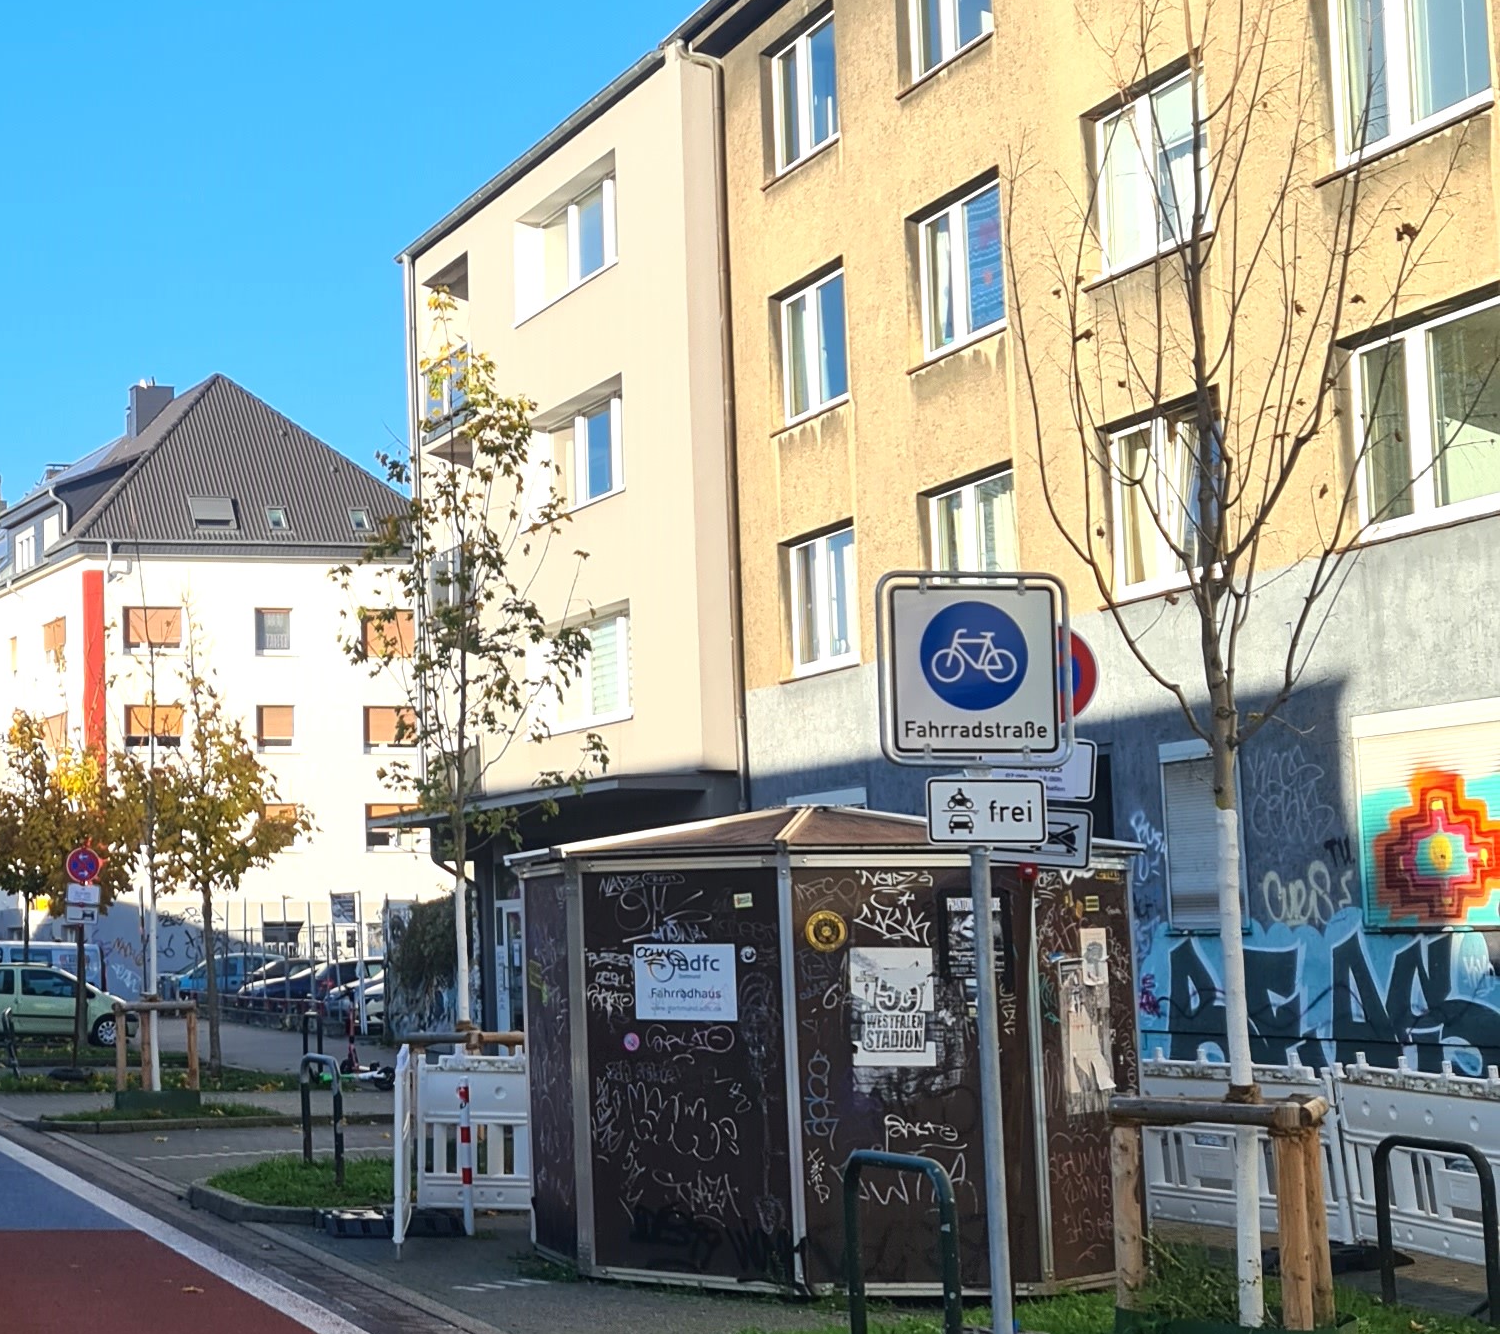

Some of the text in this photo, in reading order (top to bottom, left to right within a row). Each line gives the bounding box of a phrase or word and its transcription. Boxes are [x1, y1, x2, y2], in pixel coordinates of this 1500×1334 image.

[904, 720, 1048, 739] Fahrradstraße
[989, 800, 1033, 823] frei
[677, 953, 720, 972] adfc
[650, 987, 722, 1000] Fahrradhaus
[865, 1013, 924, 1029] WESTFALEN
[865, 1030, 925, 1049] STADION
